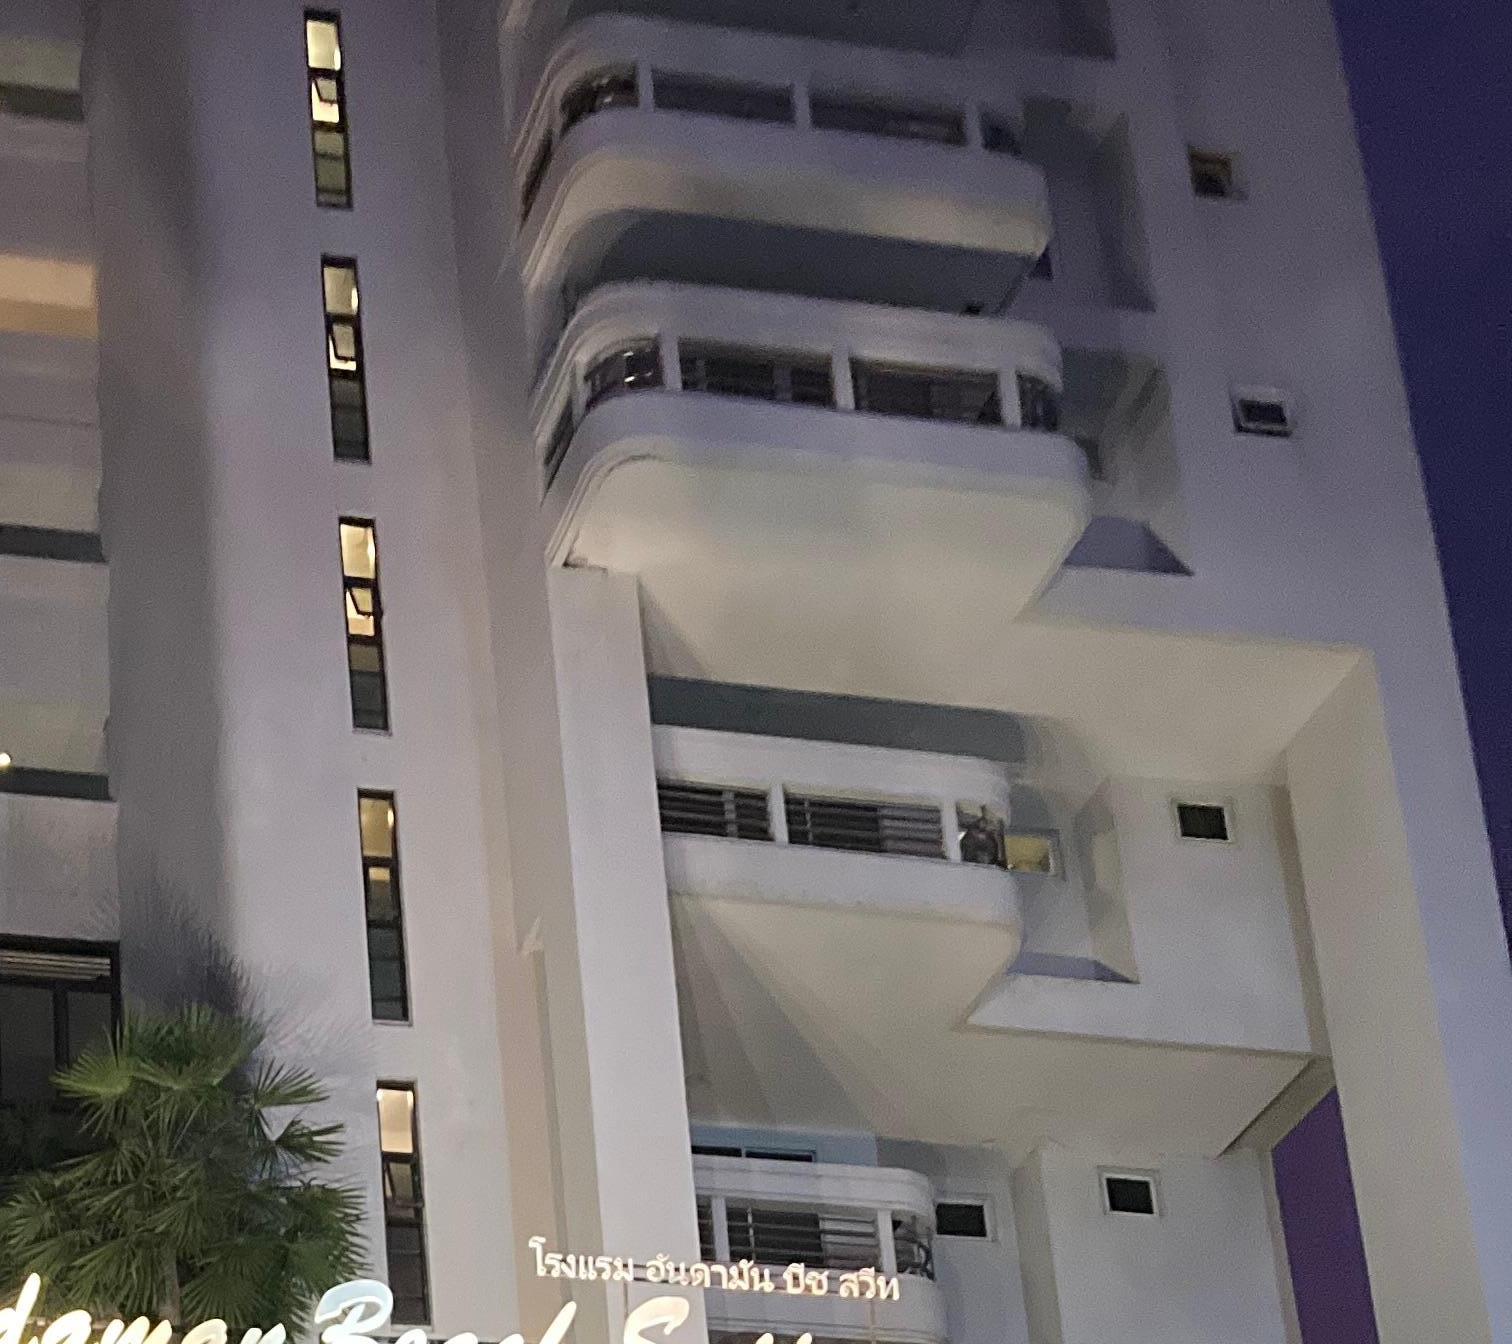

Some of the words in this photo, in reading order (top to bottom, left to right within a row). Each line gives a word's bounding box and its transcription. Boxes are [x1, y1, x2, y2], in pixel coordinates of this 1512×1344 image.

[528, 1236, 634, 1283] โรงแรม
[645, 1253, 774, 1293] อันดามัน
[782, 1261, 828, 1296] บีช
